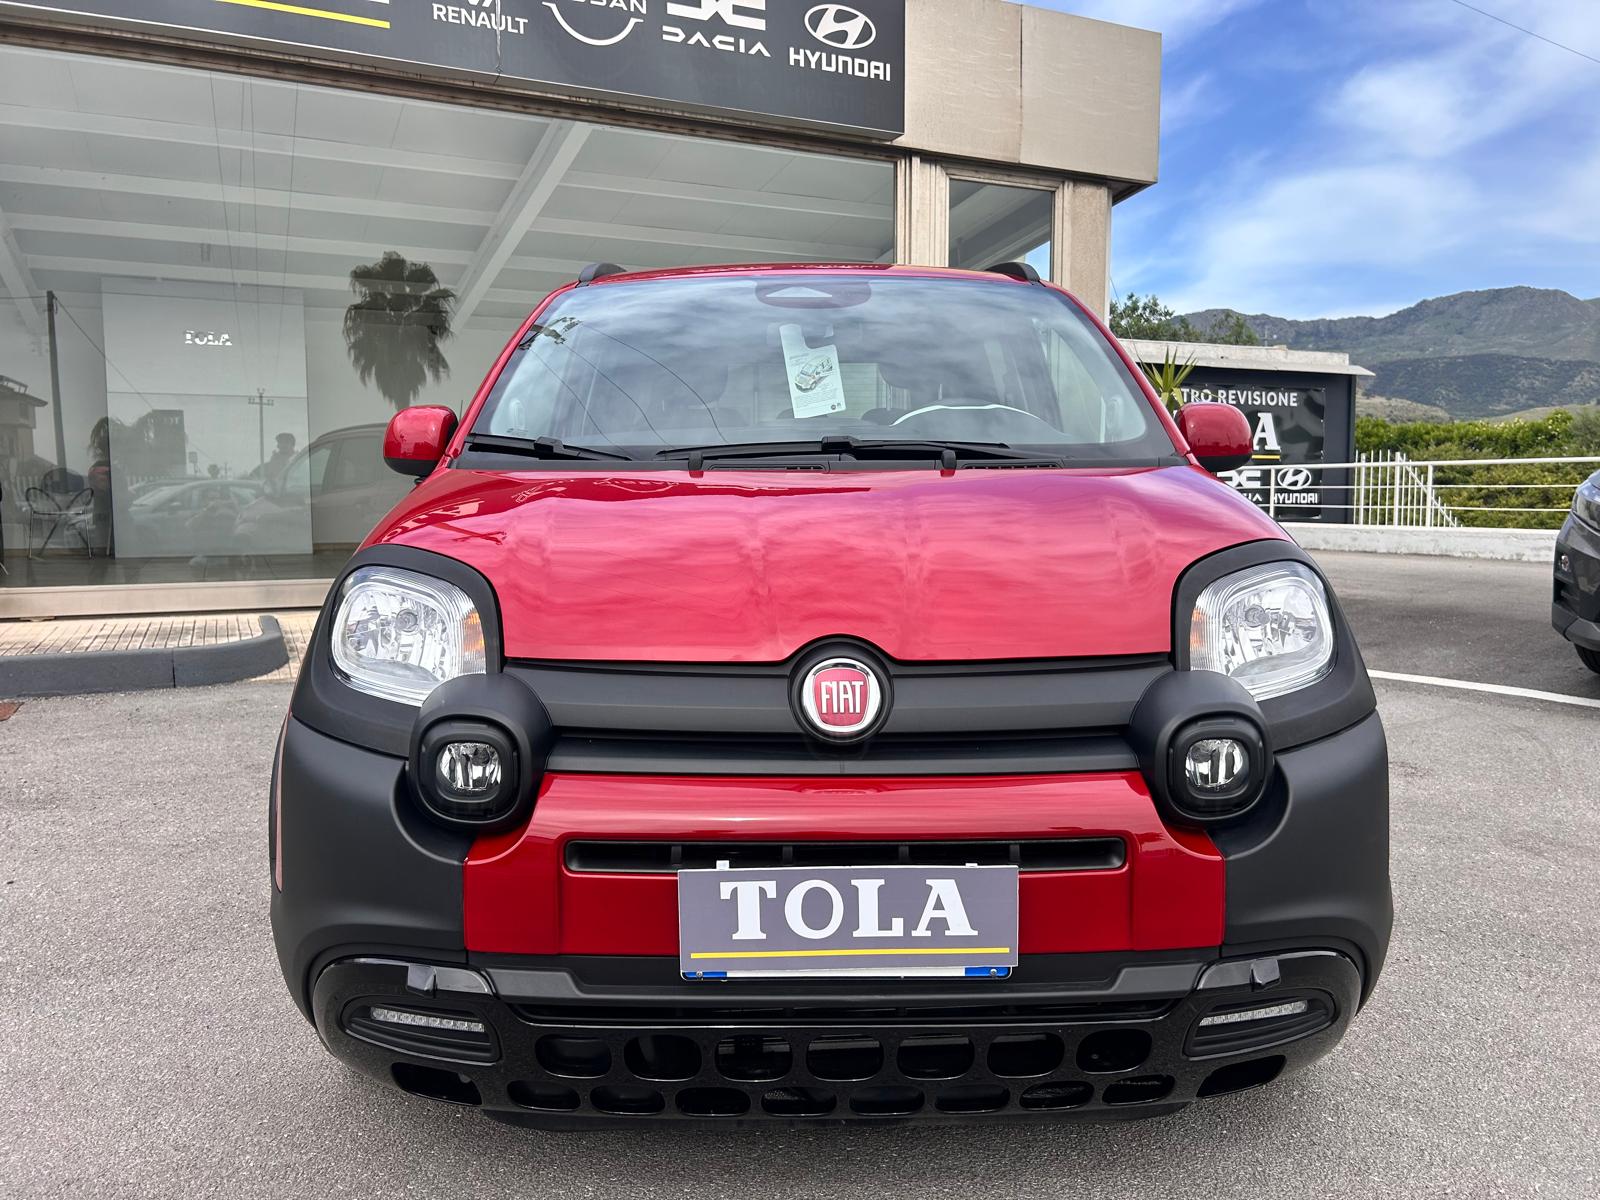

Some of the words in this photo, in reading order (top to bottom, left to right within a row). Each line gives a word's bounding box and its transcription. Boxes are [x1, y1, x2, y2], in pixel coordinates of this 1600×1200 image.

[432, 3, 529, 34] RENAULT
[662, 25, 772, 58] DACIA
[789, 47, 891, 82] HYUNDAI
[1180, 388, 1213, 403] TRO
[1217, 389, 1298, 407] REVISIONE
[820, 680, 864, 714] FIAT
[720, 879, 979, 940] TOLA
